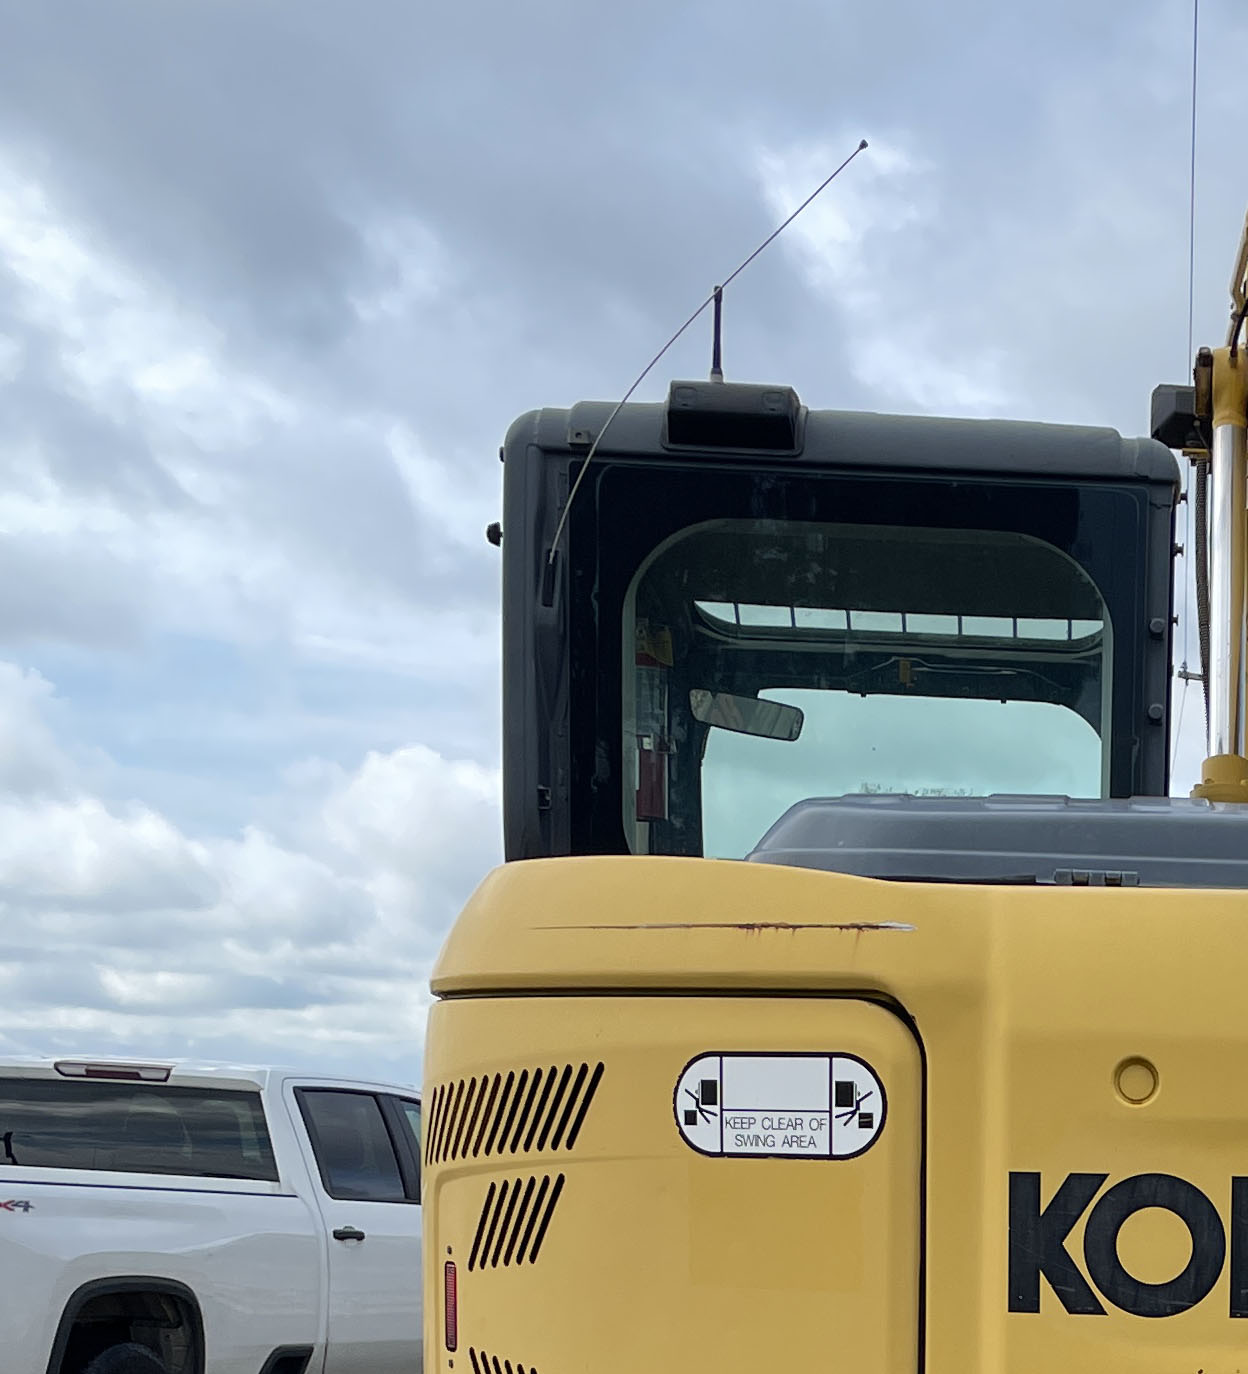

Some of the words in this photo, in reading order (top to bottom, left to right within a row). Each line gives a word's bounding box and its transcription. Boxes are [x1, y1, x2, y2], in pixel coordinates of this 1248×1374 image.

[724, 1116, 757, 1130] KEEP
[761, 1117, 804, 1131] CLEAR
[809, 1118, 828, 1132] OF
[734, 1134, 776, 1148] SWING
[781, 1135, 817, 1149] AREA
